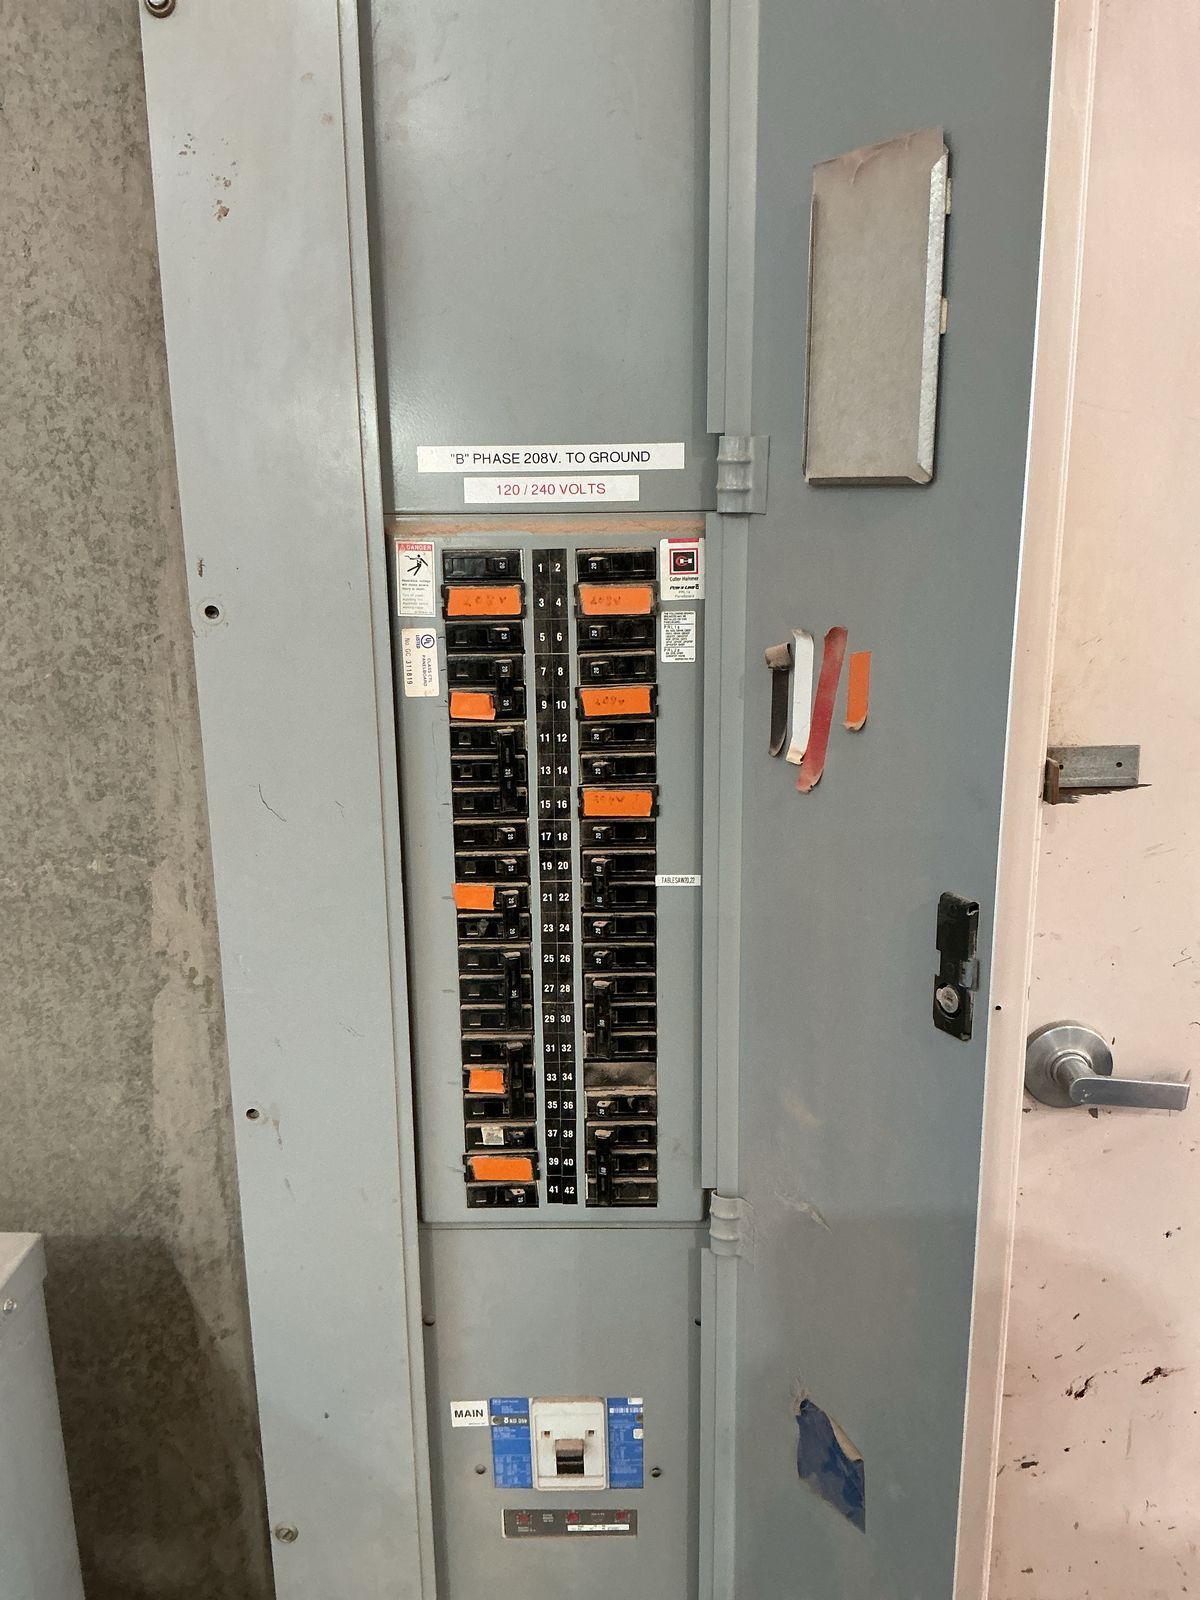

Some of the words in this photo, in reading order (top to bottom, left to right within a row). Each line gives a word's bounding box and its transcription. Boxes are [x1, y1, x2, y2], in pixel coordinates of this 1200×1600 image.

[450, 454, 469, 464] "B"
[473, 453, 520, 464] PHASE
[524, 452, 561, 464] 208V.
[566, 452, 586, 463] TO
[589, 451, 650, 463] GROUND
[496, 484, 520, 496] 120
[524, 484, 528, 496] /
[532, 484, 556, 495] 240
[559, 483, 606, 494] VOLTS
[538, 564, 542, 572] 1
[554, 562, 560, 572] 2
[538, 598, 544, 608] 3
[556, 598, 562, 606] 4
[540, 632, 546, 642] 5
[556, 632, 562, 642] 6
[540, 666, 546, 676] 7
[558, 666, 564, 676] 8
[542, 700, 548, 710] 9
[556, 700, 566, 710] 10
[540, 734, 550, 742] 11
[556, 734, 568, 742] 12
[540, 766, 550, 774] 13
[558, 766, 568, 774] 14
[540, 800, 550, 808] 15
[556, 800, 568, 808] 16
[540, 832, 552, 840] 17
[558, 832, 568, 840] 18
[542, 862, 552, 870] 19
[558, 862, 568, 870] 20
[542, 894, 552, 902] 21
[558, 892, 570, 902] 22
[544, 924, 554, 932] 23
[560, 924, 570, 932] 24
[544, 954, 554, 962] 25
[560, 954, 570, 962] 26
[544, 984, 554, 992] 27
[560, 984, 570, 992] 28
[544, 1014, 554, 1022] 29
[560, 1014, 570, 1022] 30
[546, 1044, 554, 1052] 31
[562, 1044, 572, 1052] 32
[546, 1074, 556, 1082] 33
[562, 1072, 572, 1080] 34
[548, 1100, 558, 1108] 35
[564, 1100, 574, 1108] 36
[548, 1130, 558, 1138] 37
[562, 1130, 574, 1138] 38
[548, 1158, 558, 1166] 39
[564, 1158, 574, 1166] 40
[548, 1186, 558, 1194] 41
[454, 1409, 484, 1418] MAIN
